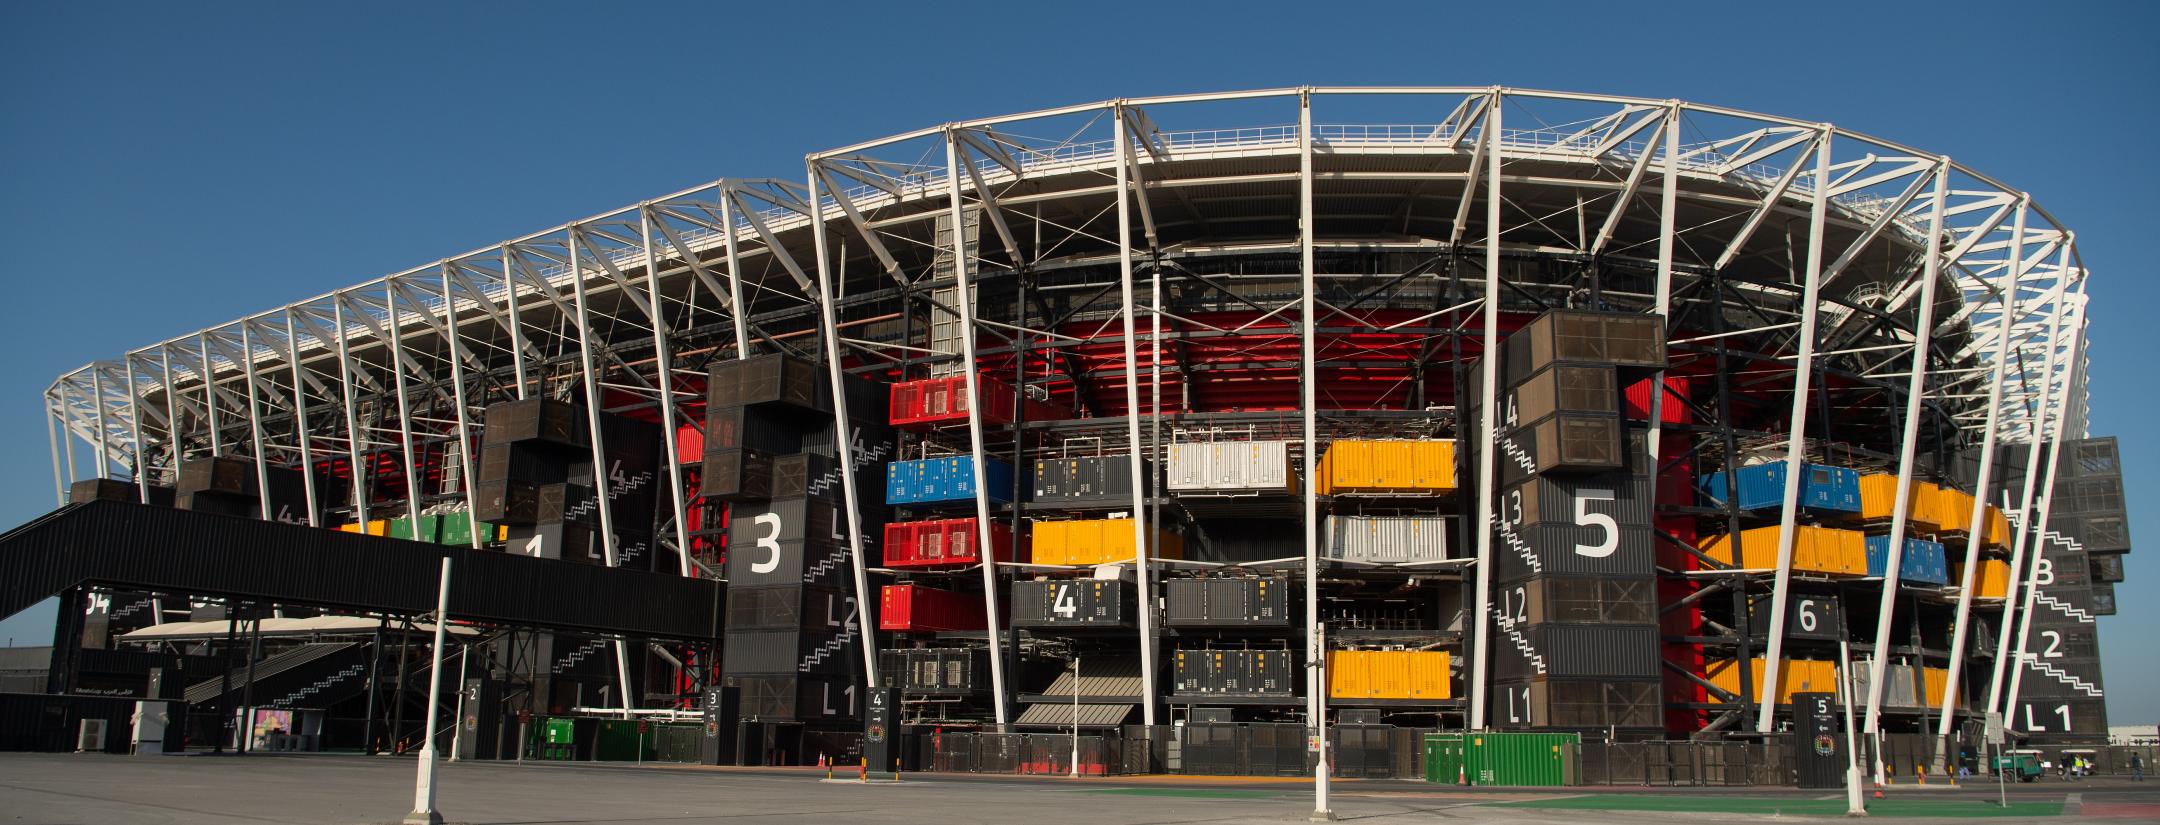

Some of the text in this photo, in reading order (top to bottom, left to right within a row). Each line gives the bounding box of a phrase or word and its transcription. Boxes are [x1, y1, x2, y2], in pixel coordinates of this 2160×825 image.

[1497, 394, 1518, 434] L4
[1501, 490, 1521, 531] L3
[1574, 489, 1619, 558] 5
[751, 513, 781, 573] 3
[827, 594, 858, 628] L2
[1053, 584, 1077, 619] 4
[1505, 586, 1527, 627] L2
[1799, 600, 1817, 632] 6
[470, 688, 477, 700] 2
[576, 682, 609, 712] L1
[710, 692, 717, 704] 3
[823, 682, 855, 716] L1
[873, 693, 882, 706] 4
[1509, 687, 1531, 723] L1
[1817, 699, 1827, 714] 5
[2025, 704, 2071, 732] L1
